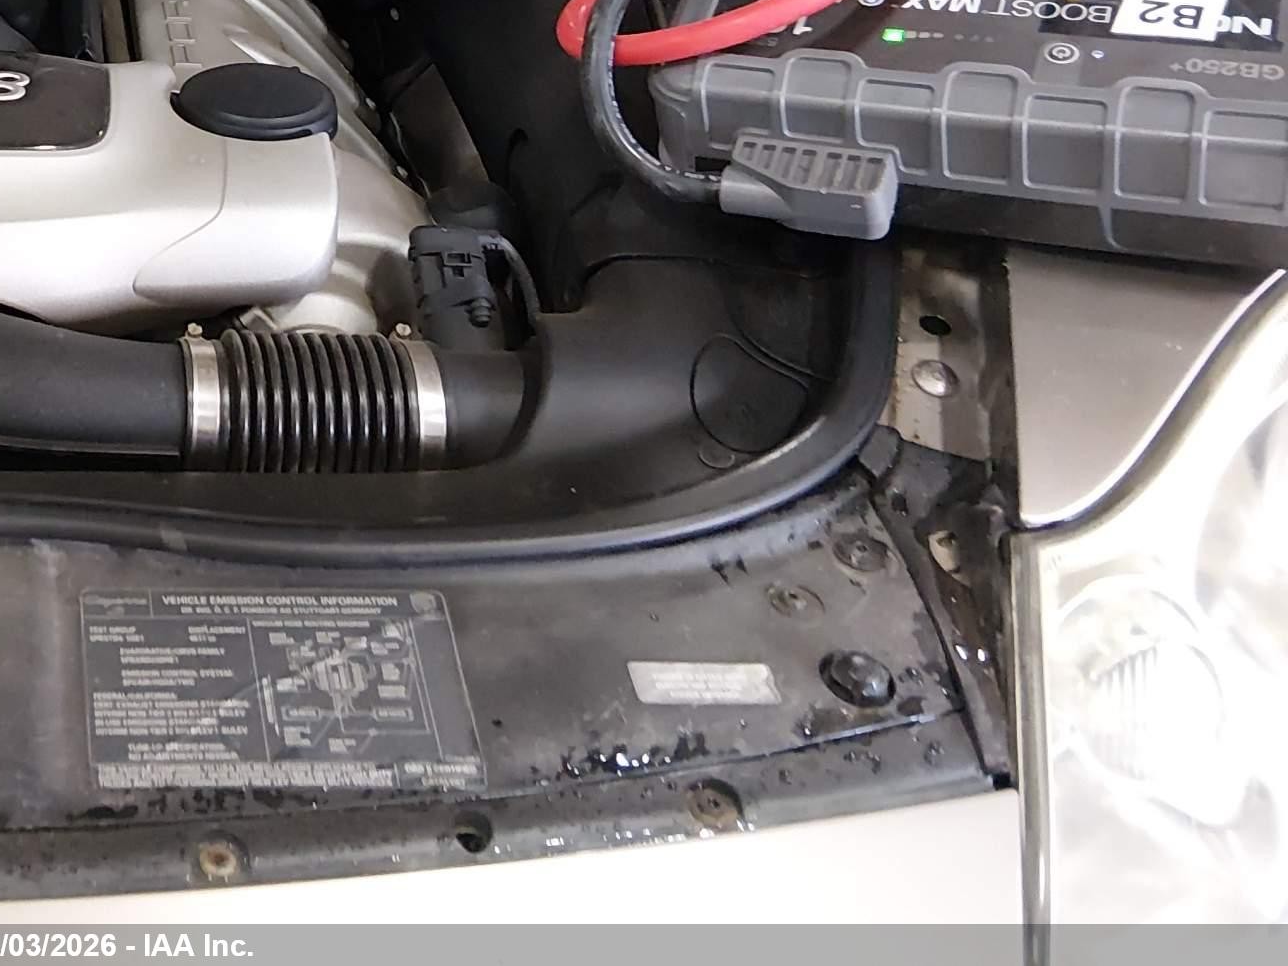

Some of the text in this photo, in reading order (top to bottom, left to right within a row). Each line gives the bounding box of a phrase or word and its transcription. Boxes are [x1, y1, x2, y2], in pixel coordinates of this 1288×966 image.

[1139, 0, 1204, 30] B2
[1168, 58, 1285, 80] GB250+
[162, 595, 398, 607] VEHICLE EMISSION CONTROL INFORMATION
